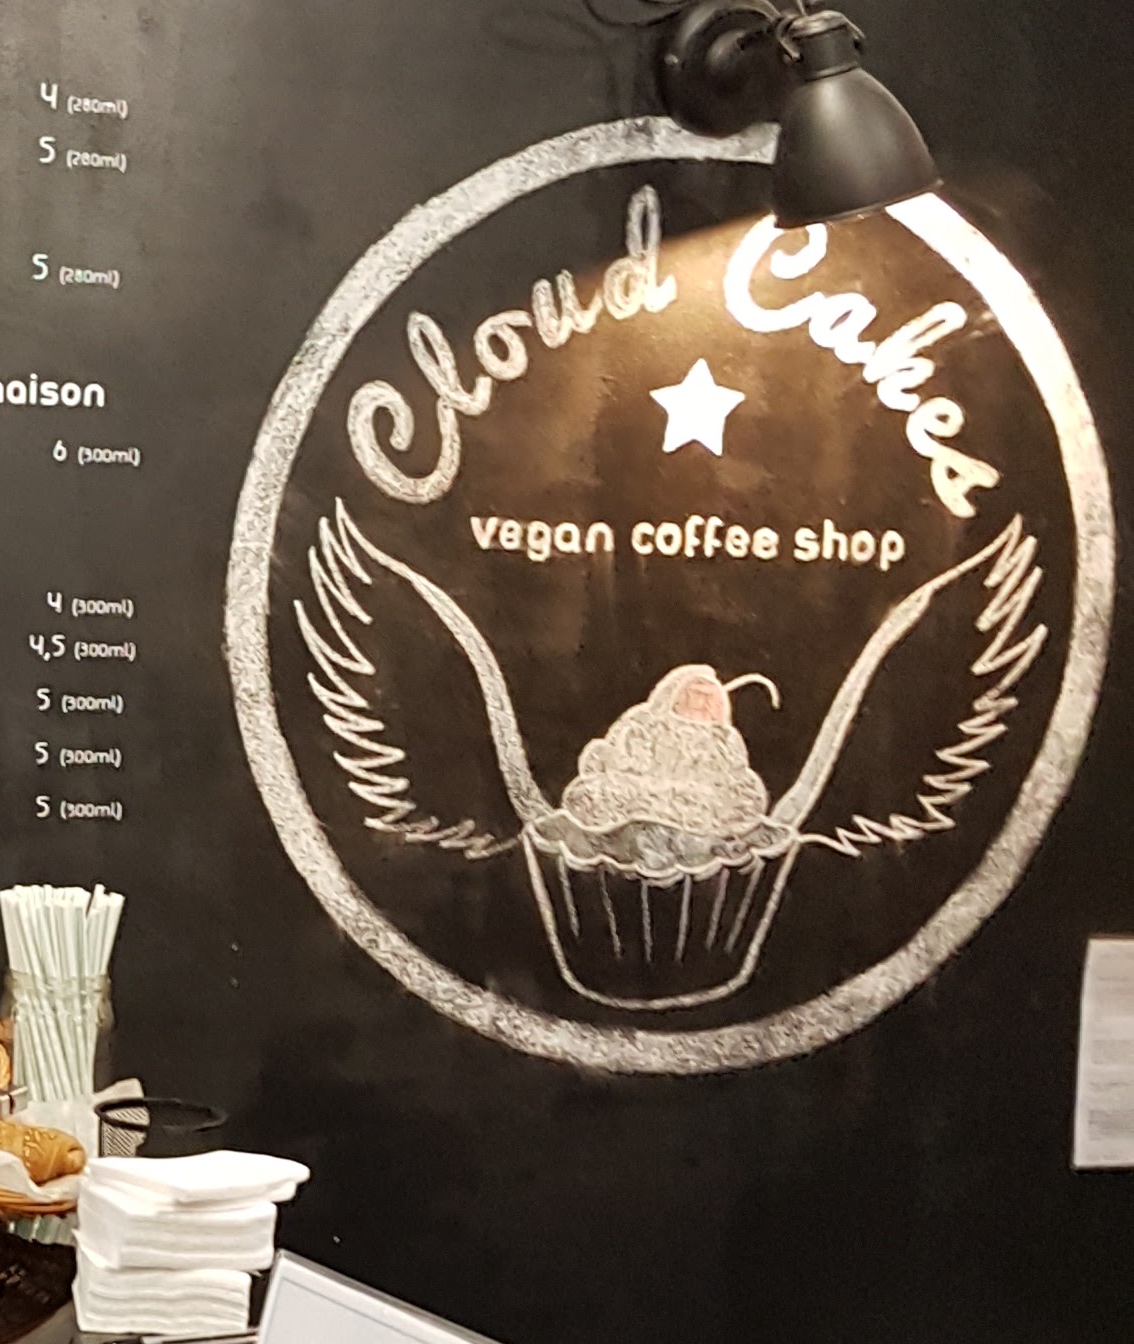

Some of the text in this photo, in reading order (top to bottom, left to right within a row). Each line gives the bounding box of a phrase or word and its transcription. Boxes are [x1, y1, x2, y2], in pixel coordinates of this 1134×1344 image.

[346, 184, 1000, 519] Cloud Cakes
[470, 513, 906, 570] vegan coffee shop
[46, 591, 134, 619] 4 (300ml)
